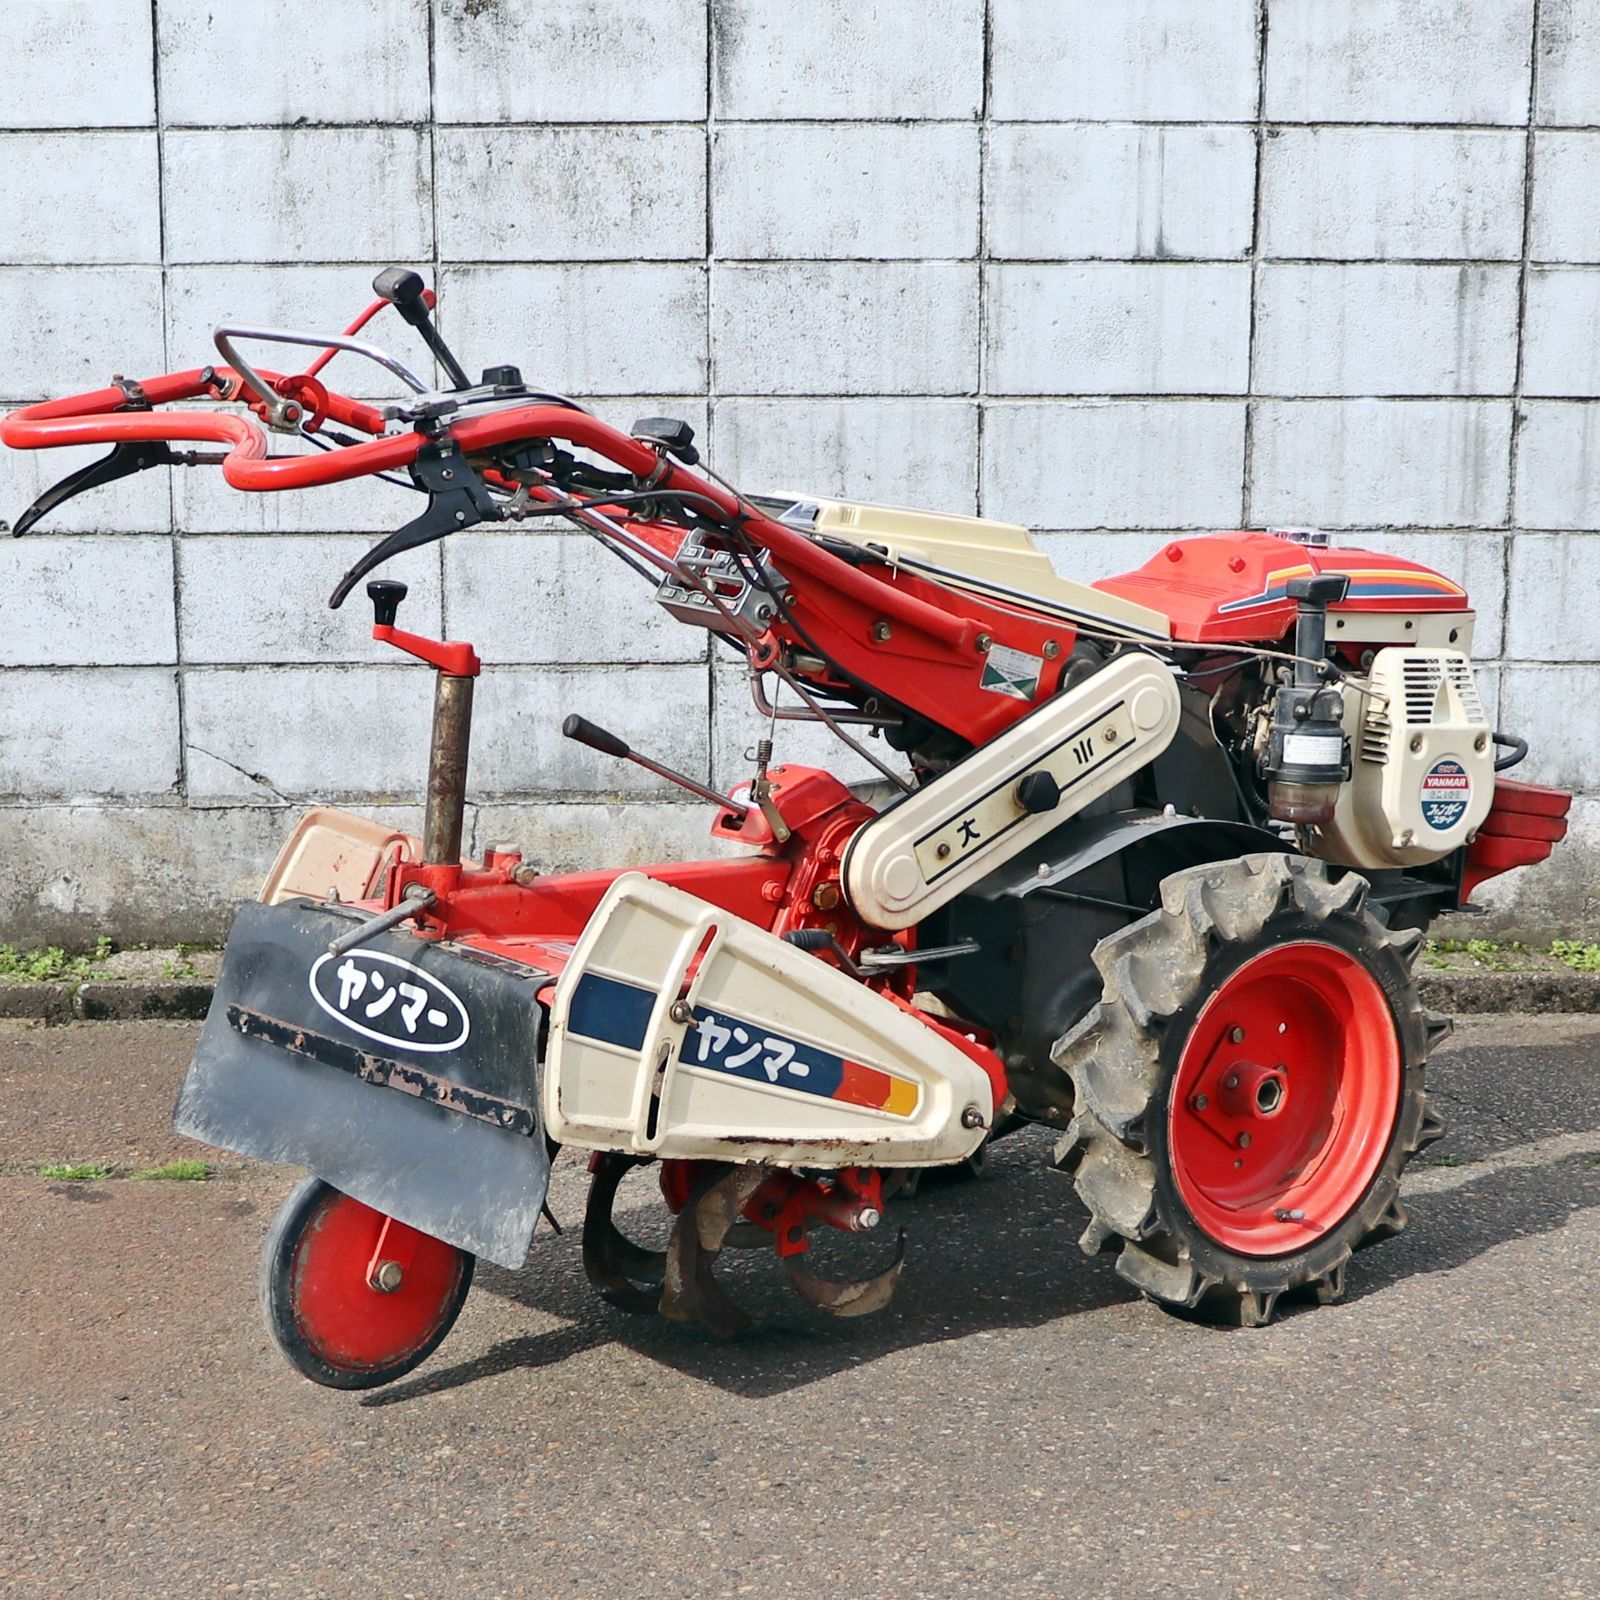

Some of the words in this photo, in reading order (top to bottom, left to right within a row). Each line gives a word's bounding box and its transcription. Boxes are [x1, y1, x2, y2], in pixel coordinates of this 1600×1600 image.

[1427, 778, 1466, 787] YANMAR
[956, 817, 981, 848] 大
[337, 958, 448, 1034] ヤンマー
[695, 1015, 810, 1082] ヤンマー
